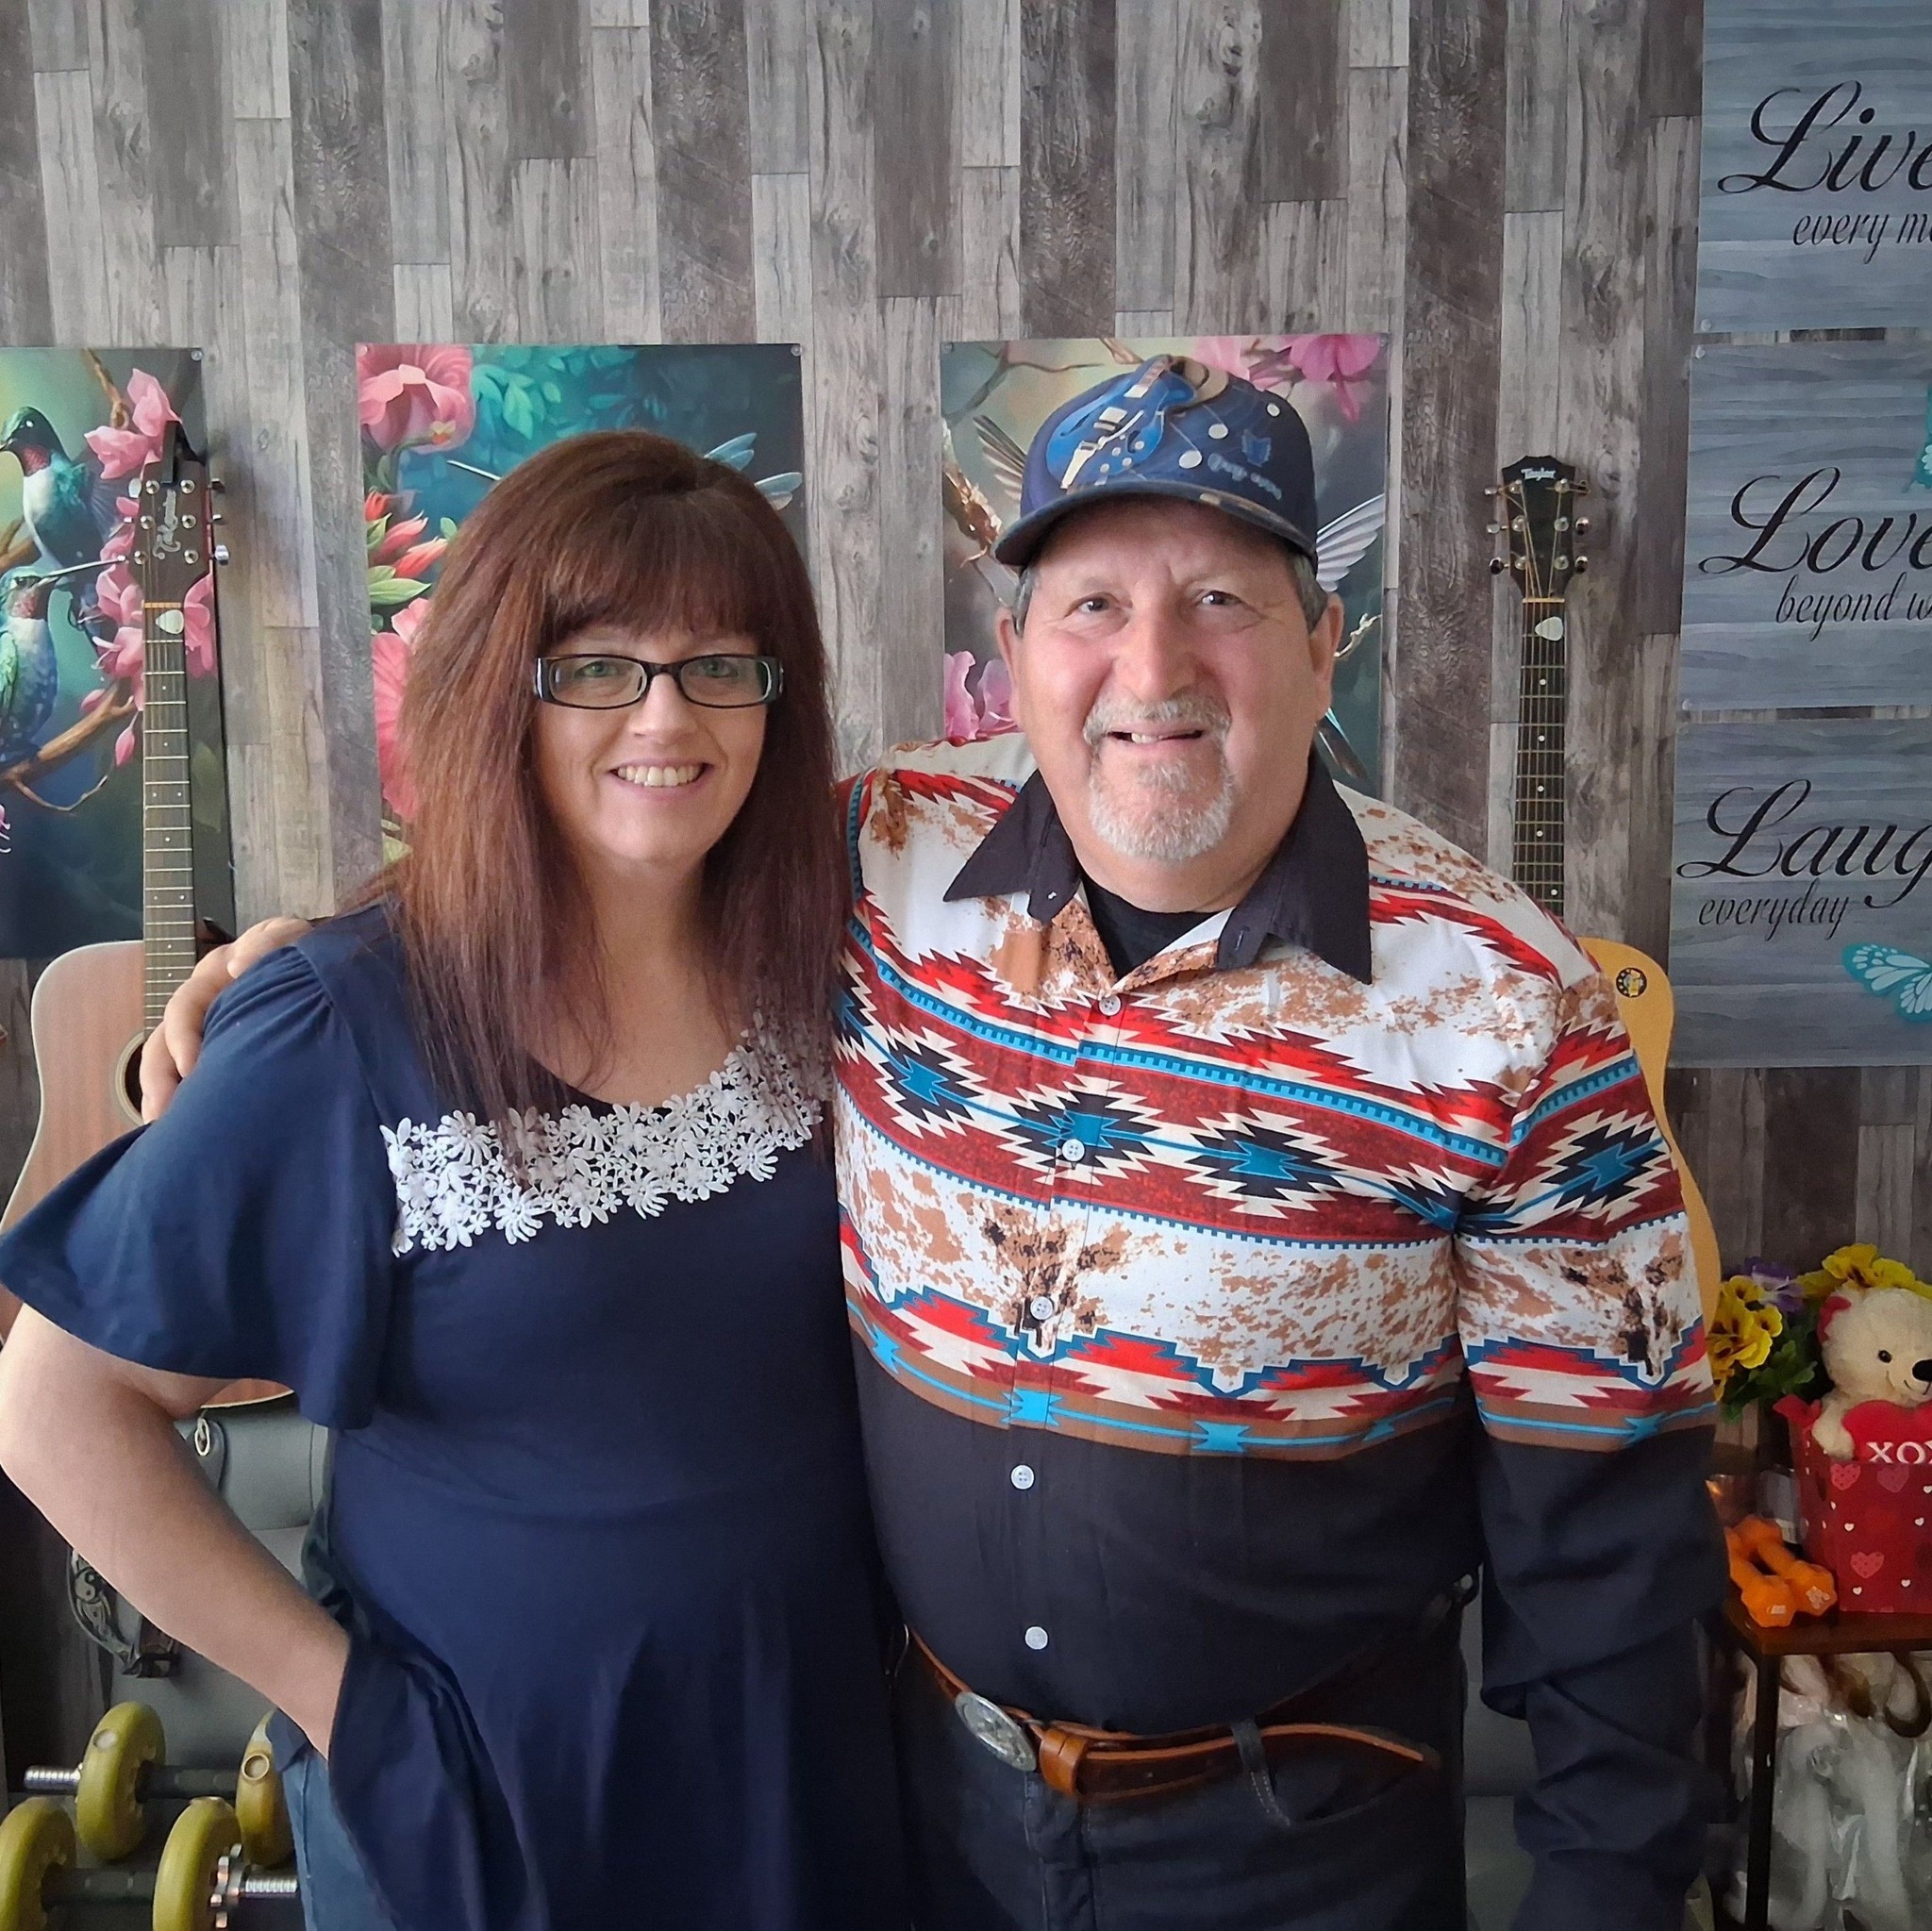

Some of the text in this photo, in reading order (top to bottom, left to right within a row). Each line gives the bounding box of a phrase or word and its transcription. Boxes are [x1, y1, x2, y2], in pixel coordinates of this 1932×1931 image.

[1717, 79, 1932, 194] Live
[1792, 212, 1890, 265] every
[1698, 466, 1932, 574] Love
[1775, 571, 1907, 642] beyond
[1698, 877, 1849, 941] everyday
